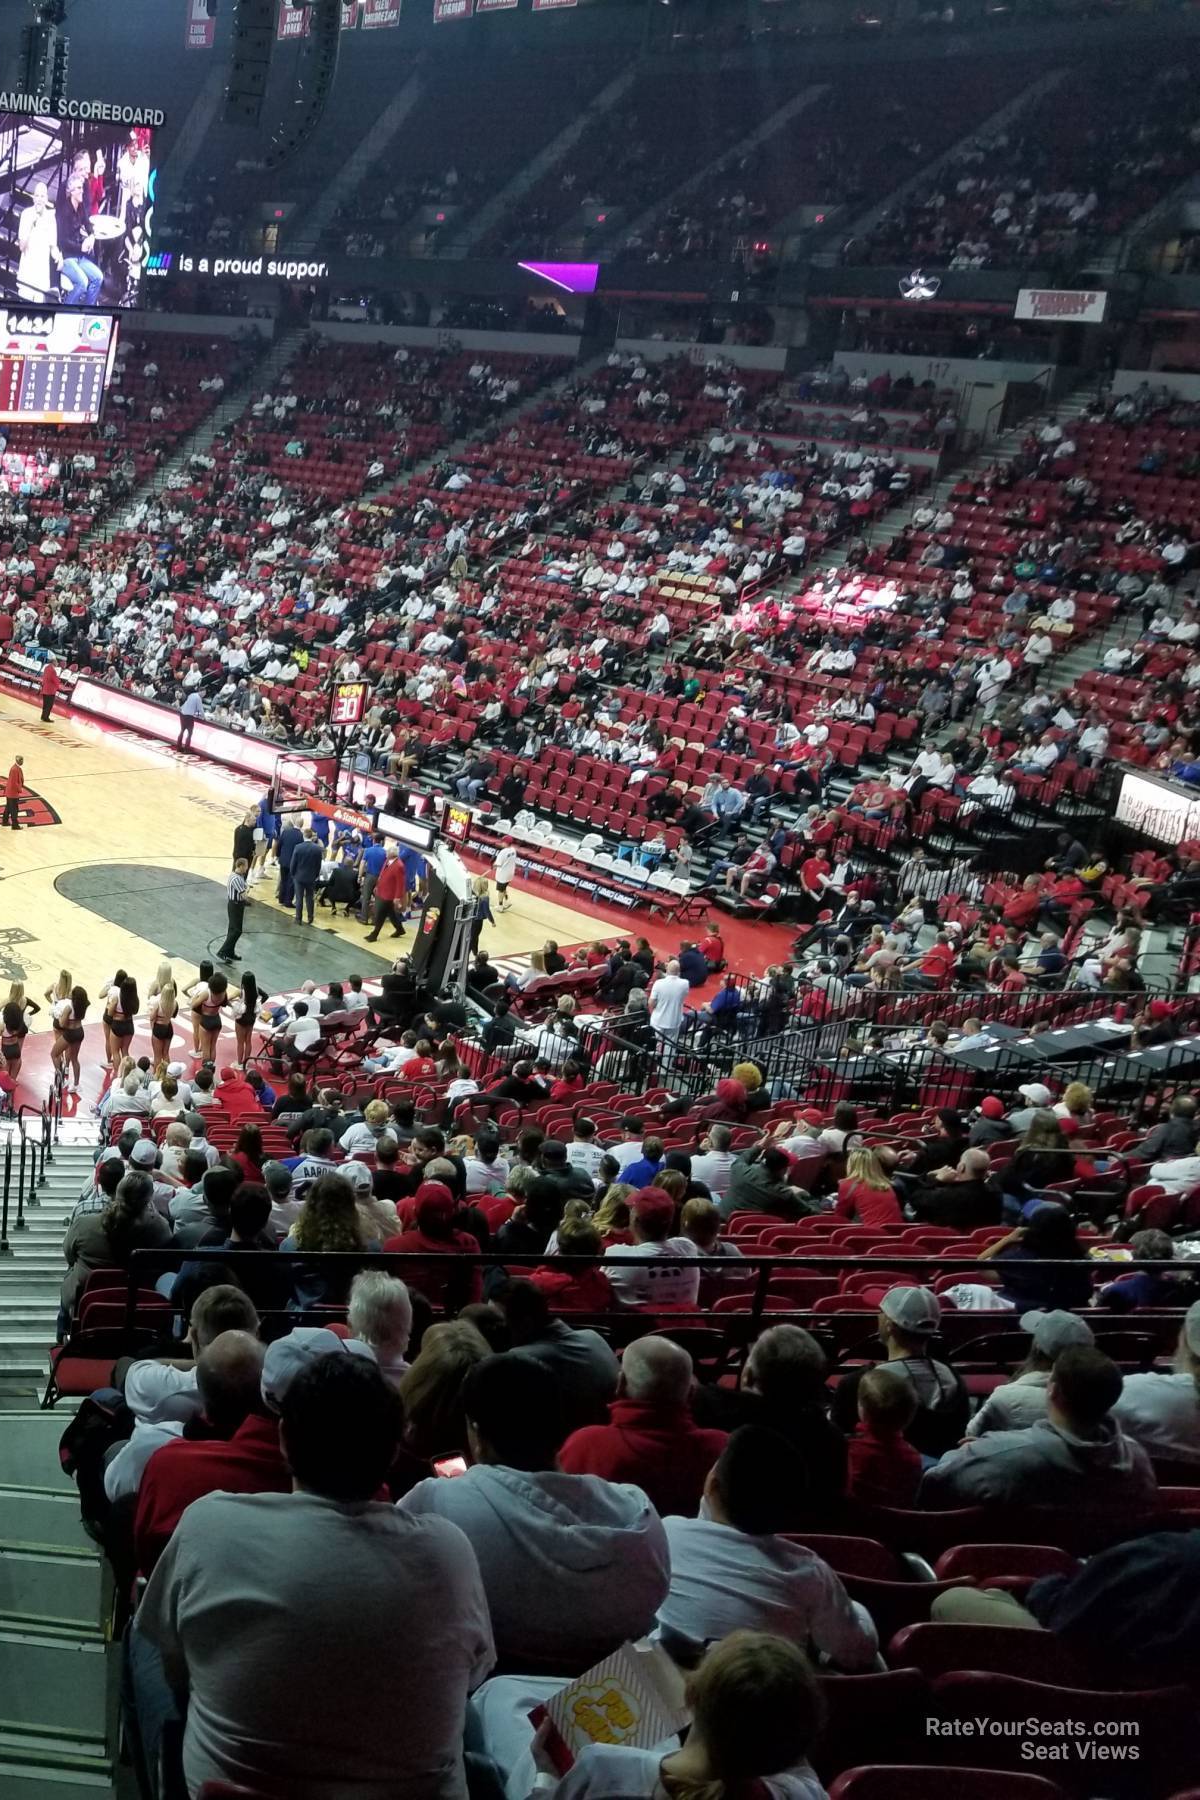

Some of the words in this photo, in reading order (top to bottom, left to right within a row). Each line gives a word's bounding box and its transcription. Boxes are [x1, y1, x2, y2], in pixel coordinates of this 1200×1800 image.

[58, 95, 165, 126] SCOREBOARD
[179, 254, 193, 272] is
[198, 257, 209, 272] a
[214, 257, 263, 277] proud
[267, 262, 329, 280] suppor
[335, 697, 357, 721] 30
